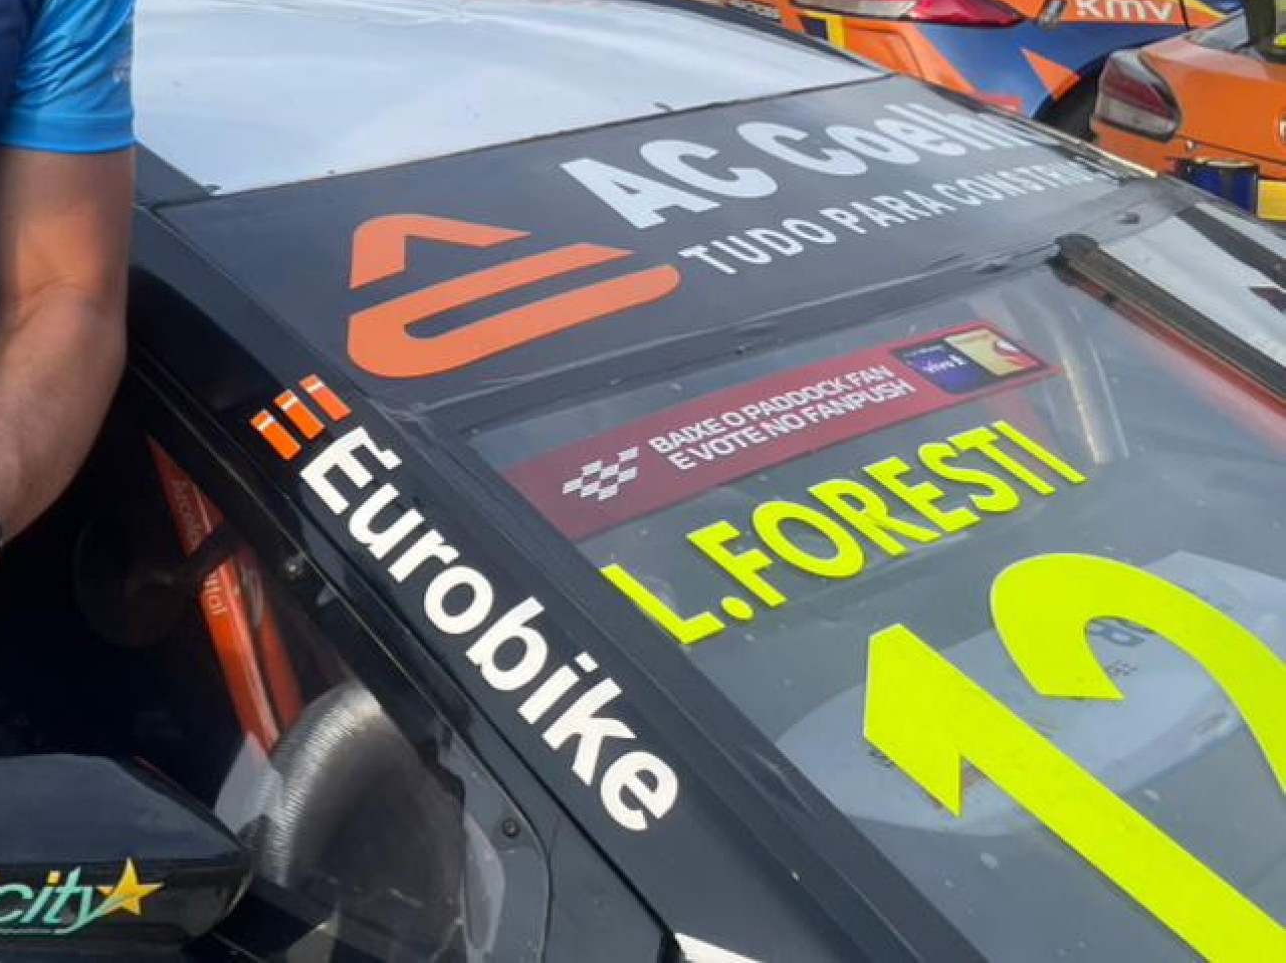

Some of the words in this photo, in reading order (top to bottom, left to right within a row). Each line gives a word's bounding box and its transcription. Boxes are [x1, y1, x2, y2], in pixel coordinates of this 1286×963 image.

[559, 139, 778, 229] AC
[677, 218, 837, 274] TUDO
[818, 189, 957, 234] PARA
[648, 417, 727, 454] BAIXE
[720, 411, 747, 427] O
[740, 376, 847, 421] PADDOCK
[845, 365, 895, 387] FAN
[666, 451, 697, 470] E
[687, 426, 768, 462] VOTE
[761, 412, 807, 438] NO
[804, 378, 917, 423] FANPUSH
[599, 420, 1088, 645] L.FORESTI
[300, 426, 680, 831] Eurobike
